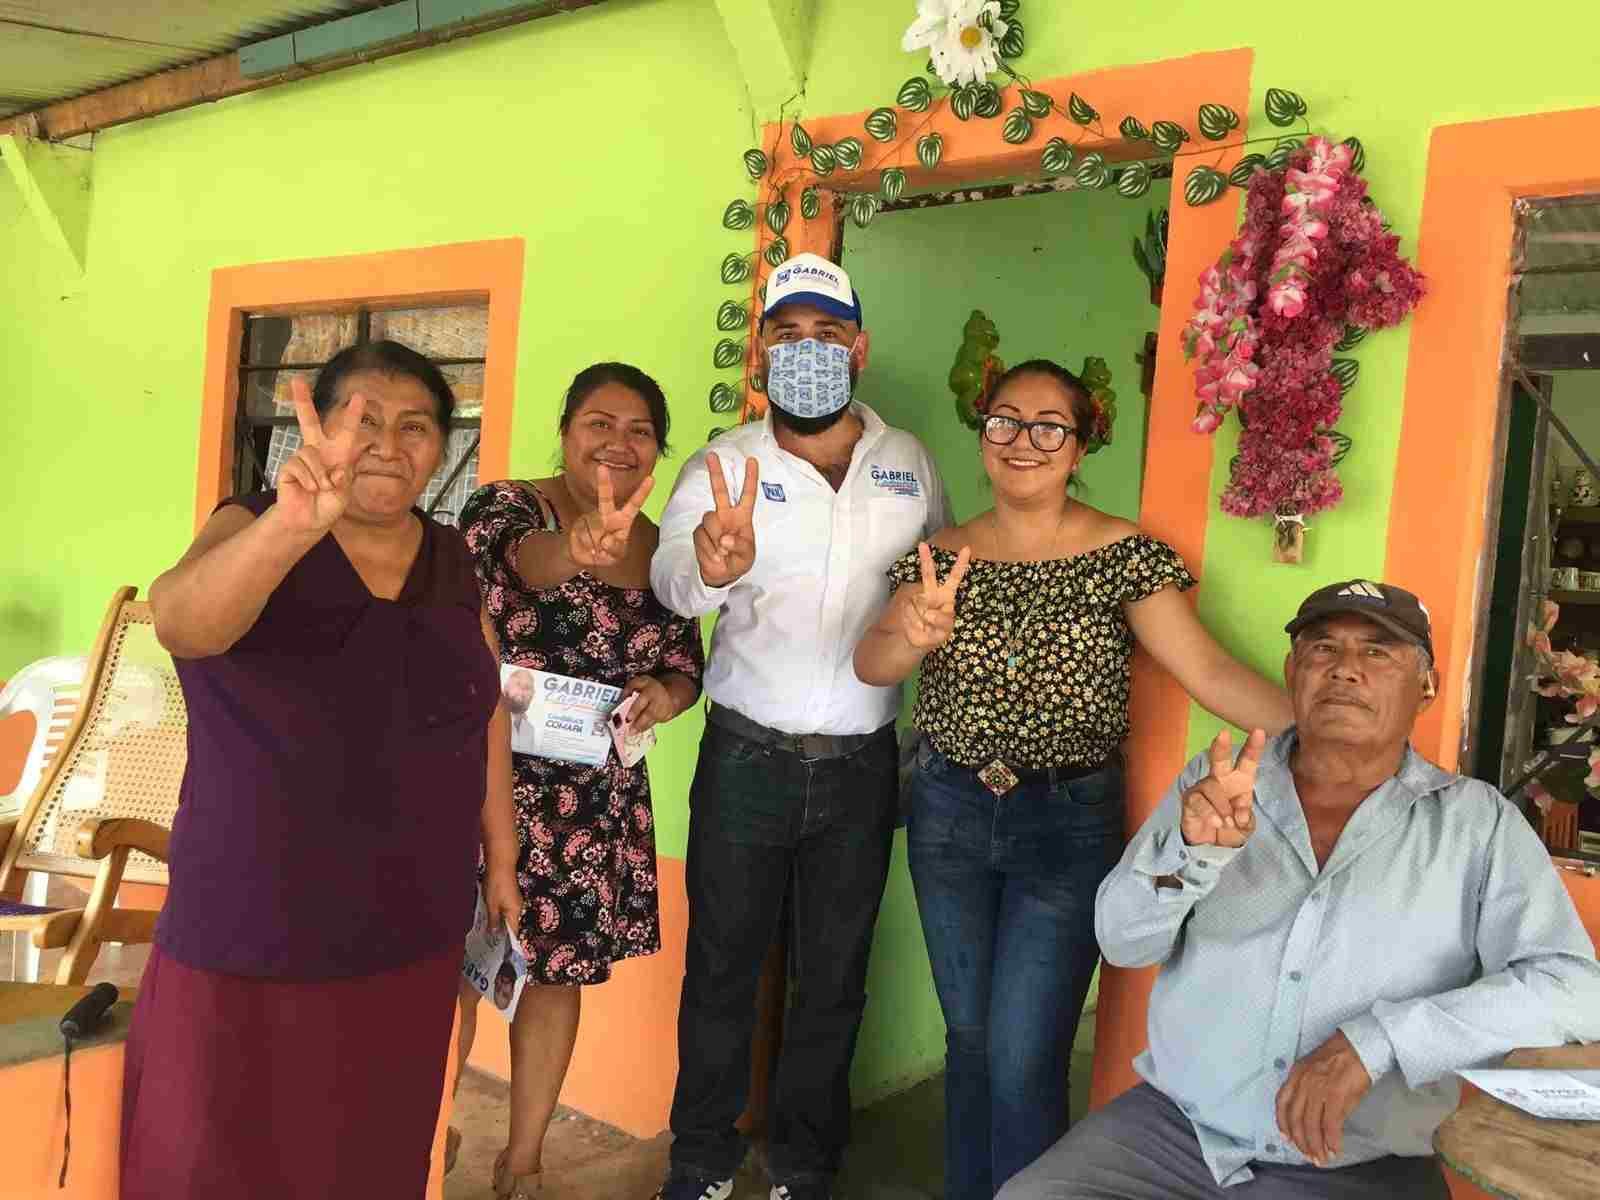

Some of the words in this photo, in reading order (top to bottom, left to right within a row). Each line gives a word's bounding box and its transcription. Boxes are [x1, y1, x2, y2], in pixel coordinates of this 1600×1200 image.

[793, 267, 840, 283] GABRIEL
[871, 470, 917, 482] GABRIEL
[544, 677, 619, 705] GABRIEL
